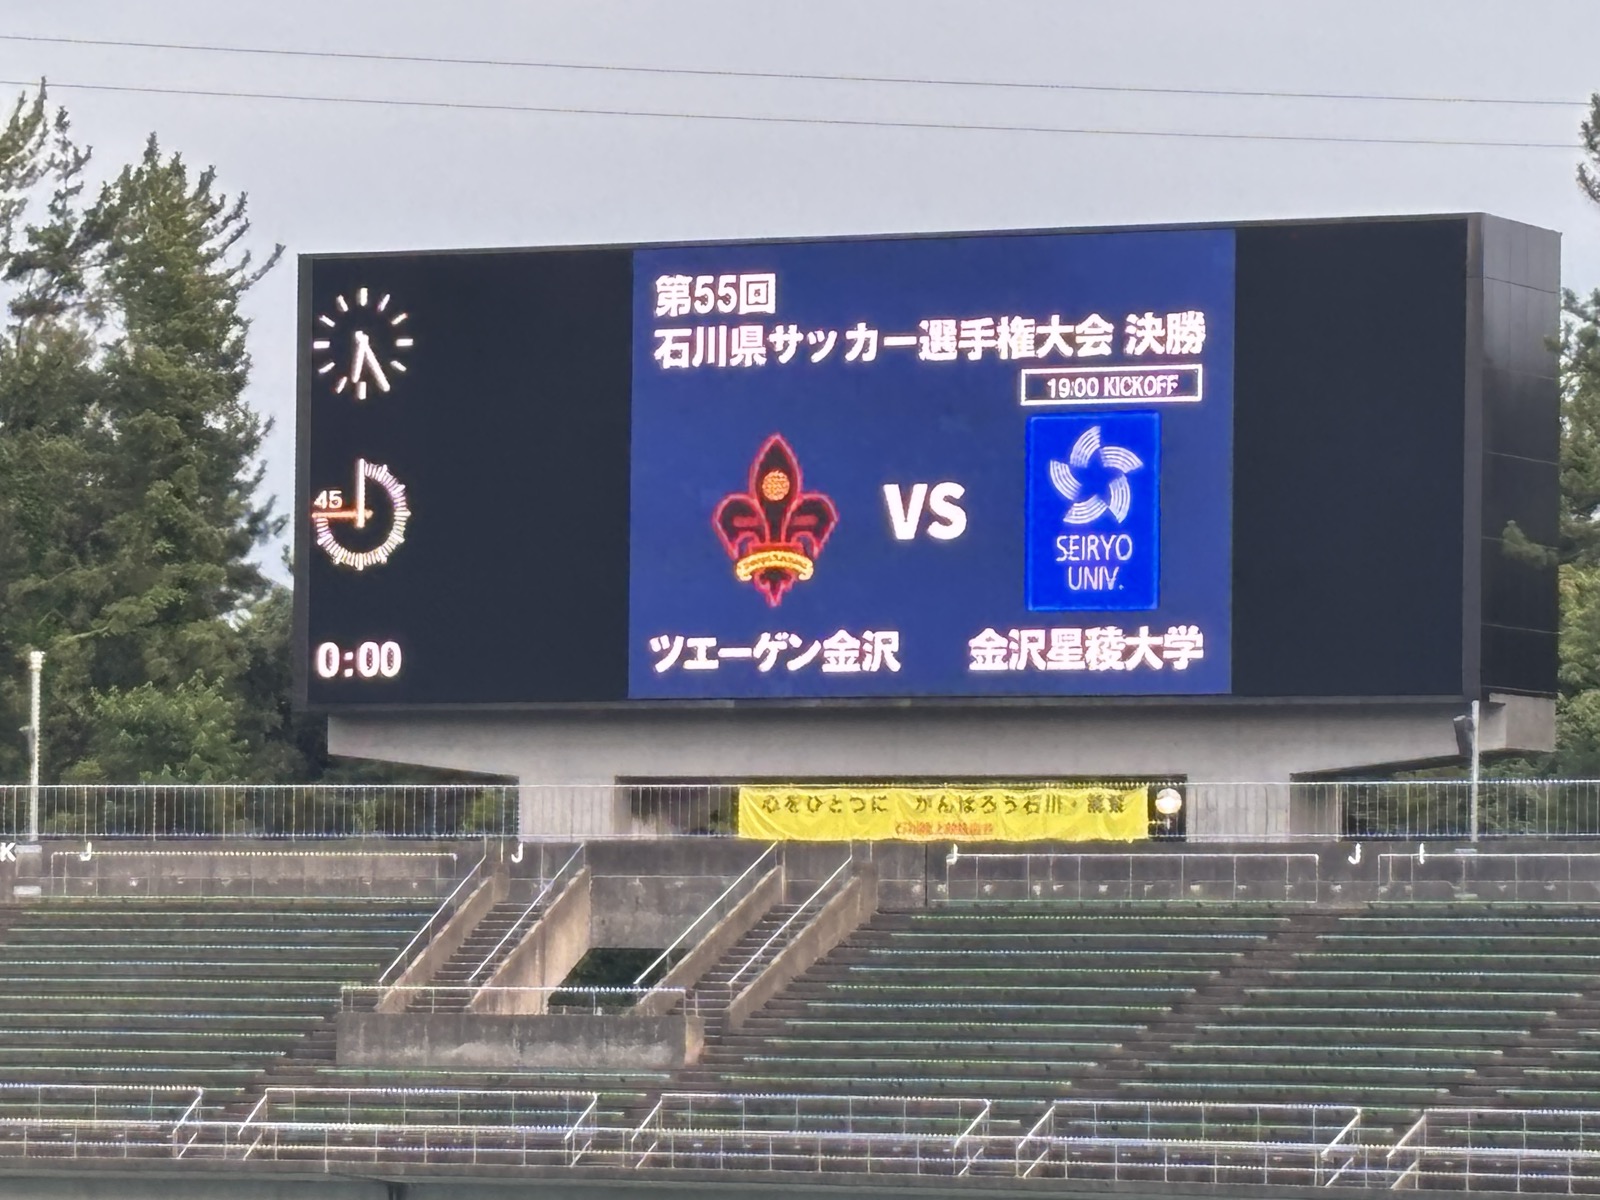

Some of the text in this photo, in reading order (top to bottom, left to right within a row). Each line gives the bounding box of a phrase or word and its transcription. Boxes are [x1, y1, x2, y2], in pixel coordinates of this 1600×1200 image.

[654, 273, 776, 318] 第55回
[652, 310, 1207, 370] 石川県サッカー選手権大会 決勝
[1047, 376, 1099, 398] 19:00
[313, 490, 343, 509] 45
[882, 482, 967, 541] VS
[1056, 533, 1133, 563] SEIRYO
[1067, 566, 1123, 592] UNIV.
[316, 641, 402, 678] 0:00
[649, 630, 901, 675] ツエーゲン金沢
[968, 625, 1205, 673] 金沢星稜大学
[0, 842, 16, 862] K
[511, 842, 524, 863] J
[1347, 842, 1361, 865] J
